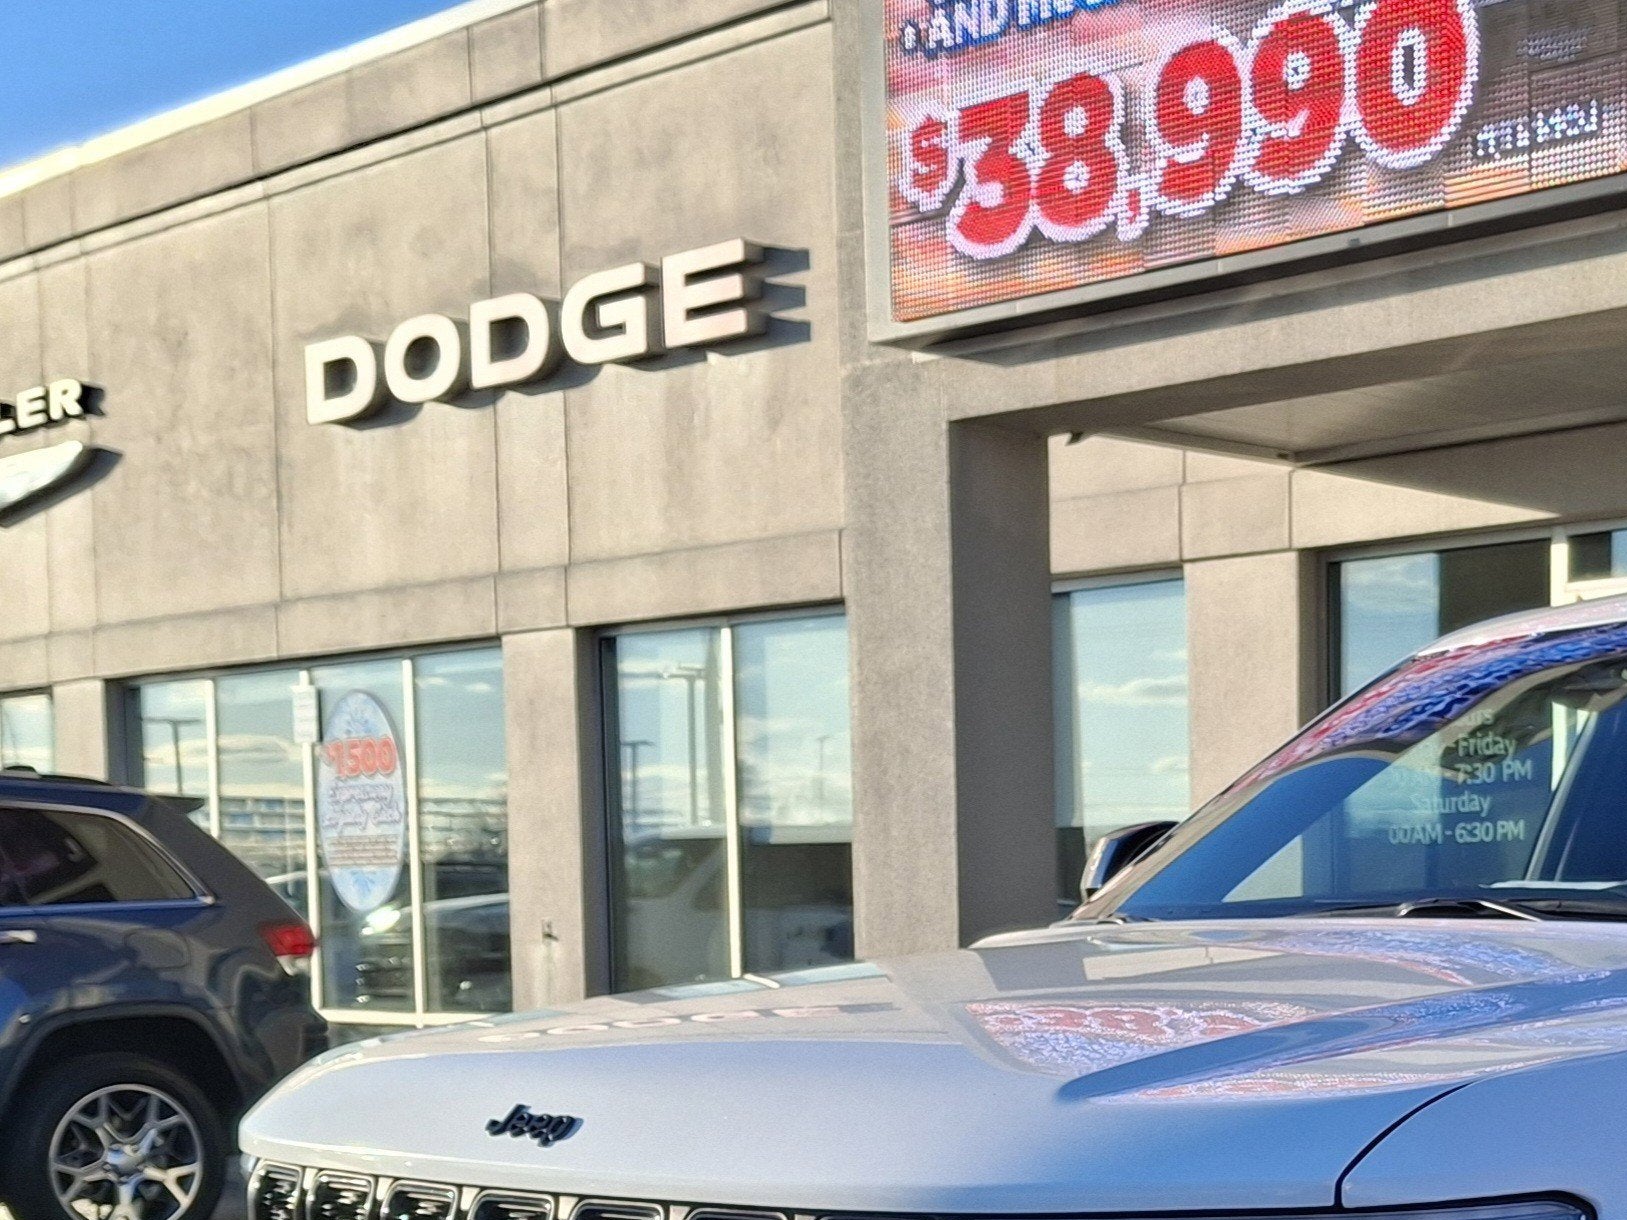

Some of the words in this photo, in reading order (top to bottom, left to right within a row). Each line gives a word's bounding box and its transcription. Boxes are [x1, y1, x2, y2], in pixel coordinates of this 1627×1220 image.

[905, 0, 1482, 258] $38,990
[305, 237, 760, 425] DODGE
[1457, 730, 1517, 762] Friday
[1502, 758, 1532, 782] PM
[1410, 790, 1491, 818] Saturday
[1496, 818, 1526, 842] PM
[485, 1103, 583, 1148] Jeep
